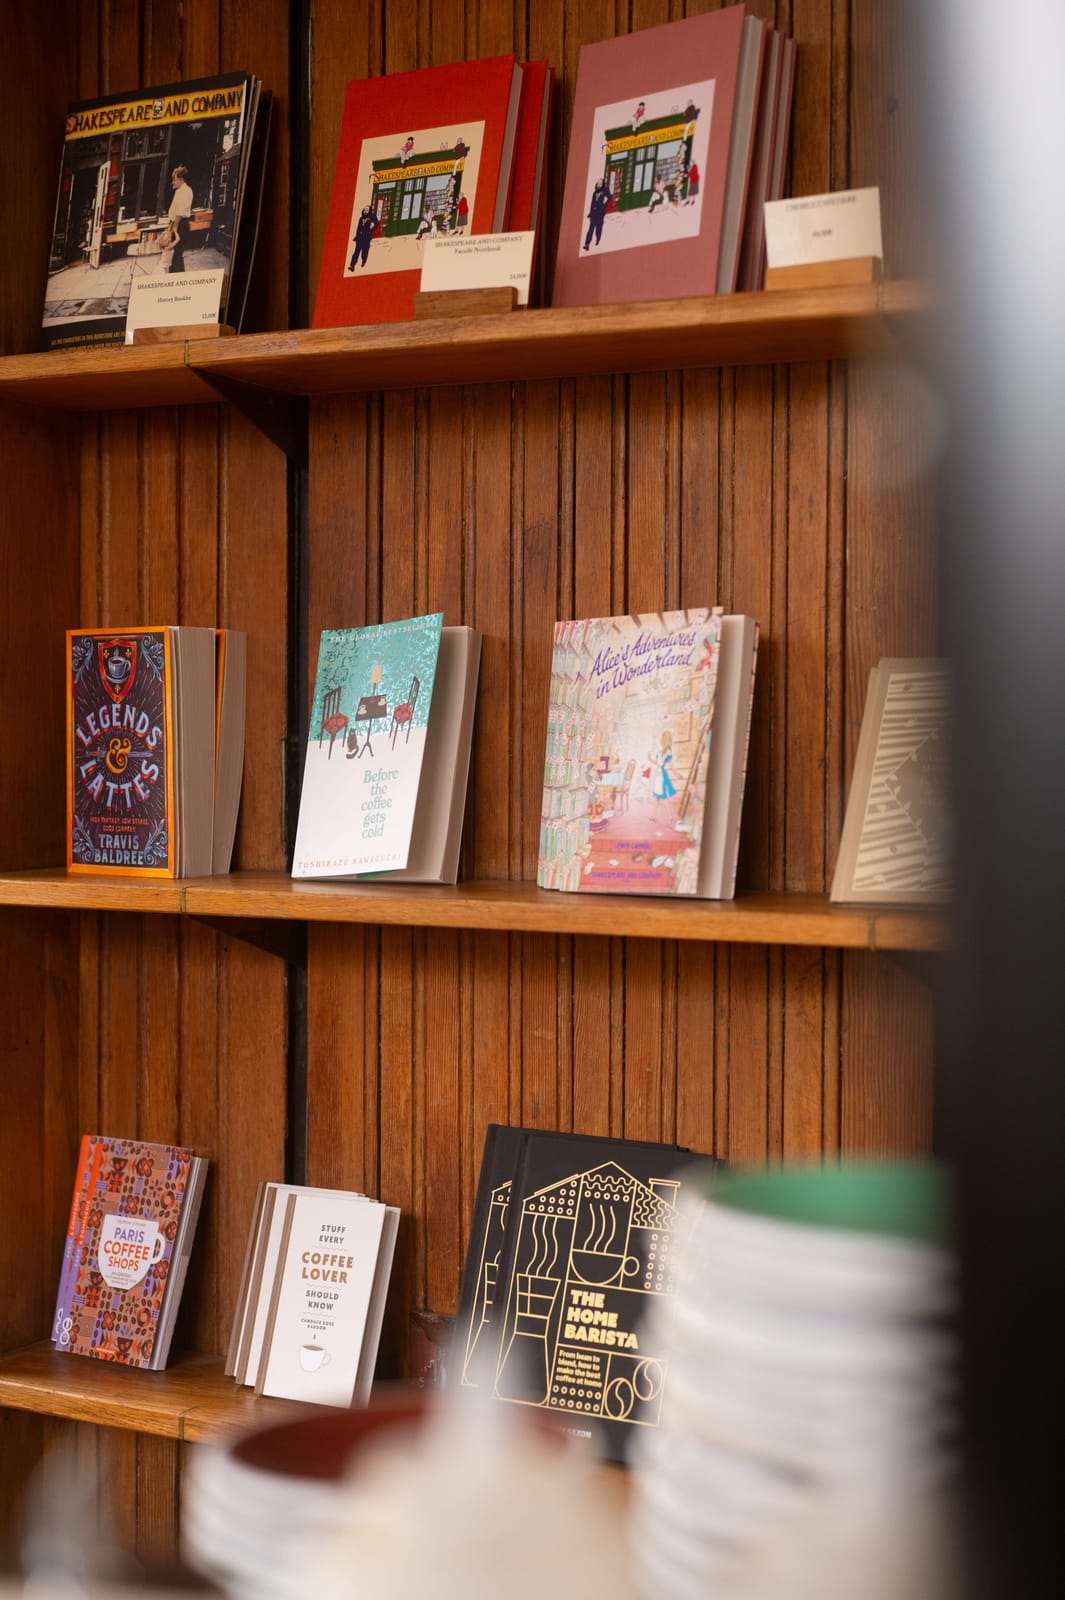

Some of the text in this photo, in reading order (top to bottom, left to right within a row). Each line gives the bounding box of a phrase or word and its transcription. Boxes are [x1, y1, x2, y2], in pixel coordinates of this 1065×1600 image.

[66, 89, 243, 134] SHAKESPEARE AND COMPANY
[588, 632, 696, 684] Alice's Adventures
[596, 648, 696, 699] in Wonderland
[76, 702, 162, 750] LEGENDS
[106, 738, 132, 773] &
[364, 768, 398, 784] Before
[80, 759, 159, 811] LATTES
[371, 783, 388, 796] the
[361, 796, 392, 811] coffee
[364, 812, 386, 828] gets
[362, 824, 384, 839] cold
[98, 834, 140, 850] TRAVIS
[94, 848, 144, 865] BALDREE
[114, 1227, 144, 1244] PARIS
[321, 1224, 346, 1235] STUFF
[319, 1235, 344, 1245] EVERY
[104, 1240, 150, 1260] COFFEE
[108, 1256, 140, 1272] SHOPS
[301, 1251, 354, 1269] COFFEE
[301, 1267, 348, 1284] LOVER
[306, 1290, 339, 1301] SHOULD
[570, 1289, 606, 1309] THE
[308, 1301, 334, 1311] KNOW
[567, 1307, 618, 1328] HOME
[564, 1324, 638, 1350] BARISTA
[558, 1358, 577, 1368] blend,
[578, 1361, 592, 1370] how
[560, 1350, 600, 1363] From bean to
[556, 1367, 601, 1379] make the best
[556, 1374, 576, 1384] coffee
[584, 1378, 602, 1388] home
